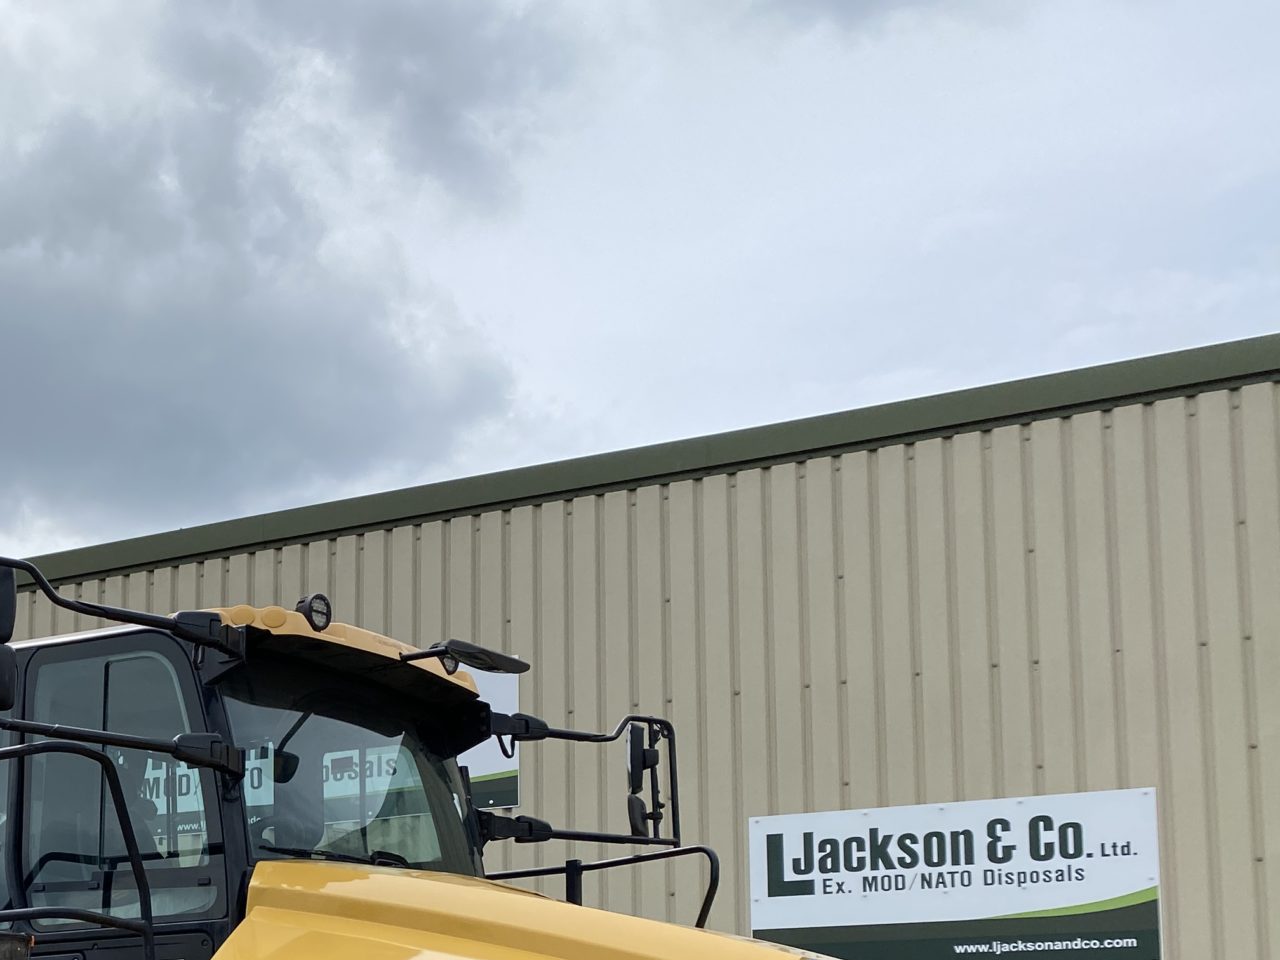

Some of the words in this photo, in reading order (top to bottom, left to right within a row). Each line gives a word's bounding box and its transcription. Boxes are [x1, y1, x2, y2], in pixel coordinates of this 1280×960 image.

[986, 818, 1017, 864] &
[1028, 814, 1094, 862] Co.
[1100, 841, 1138, 858] Ltd.
[822, 877, 853, 895] Ex.
[862, 869, 973, 893] MOD/NATO
[983, 864, 1086, 888] Disposals
[953, 937, 1138, 955] www.ljacksonandco.com
